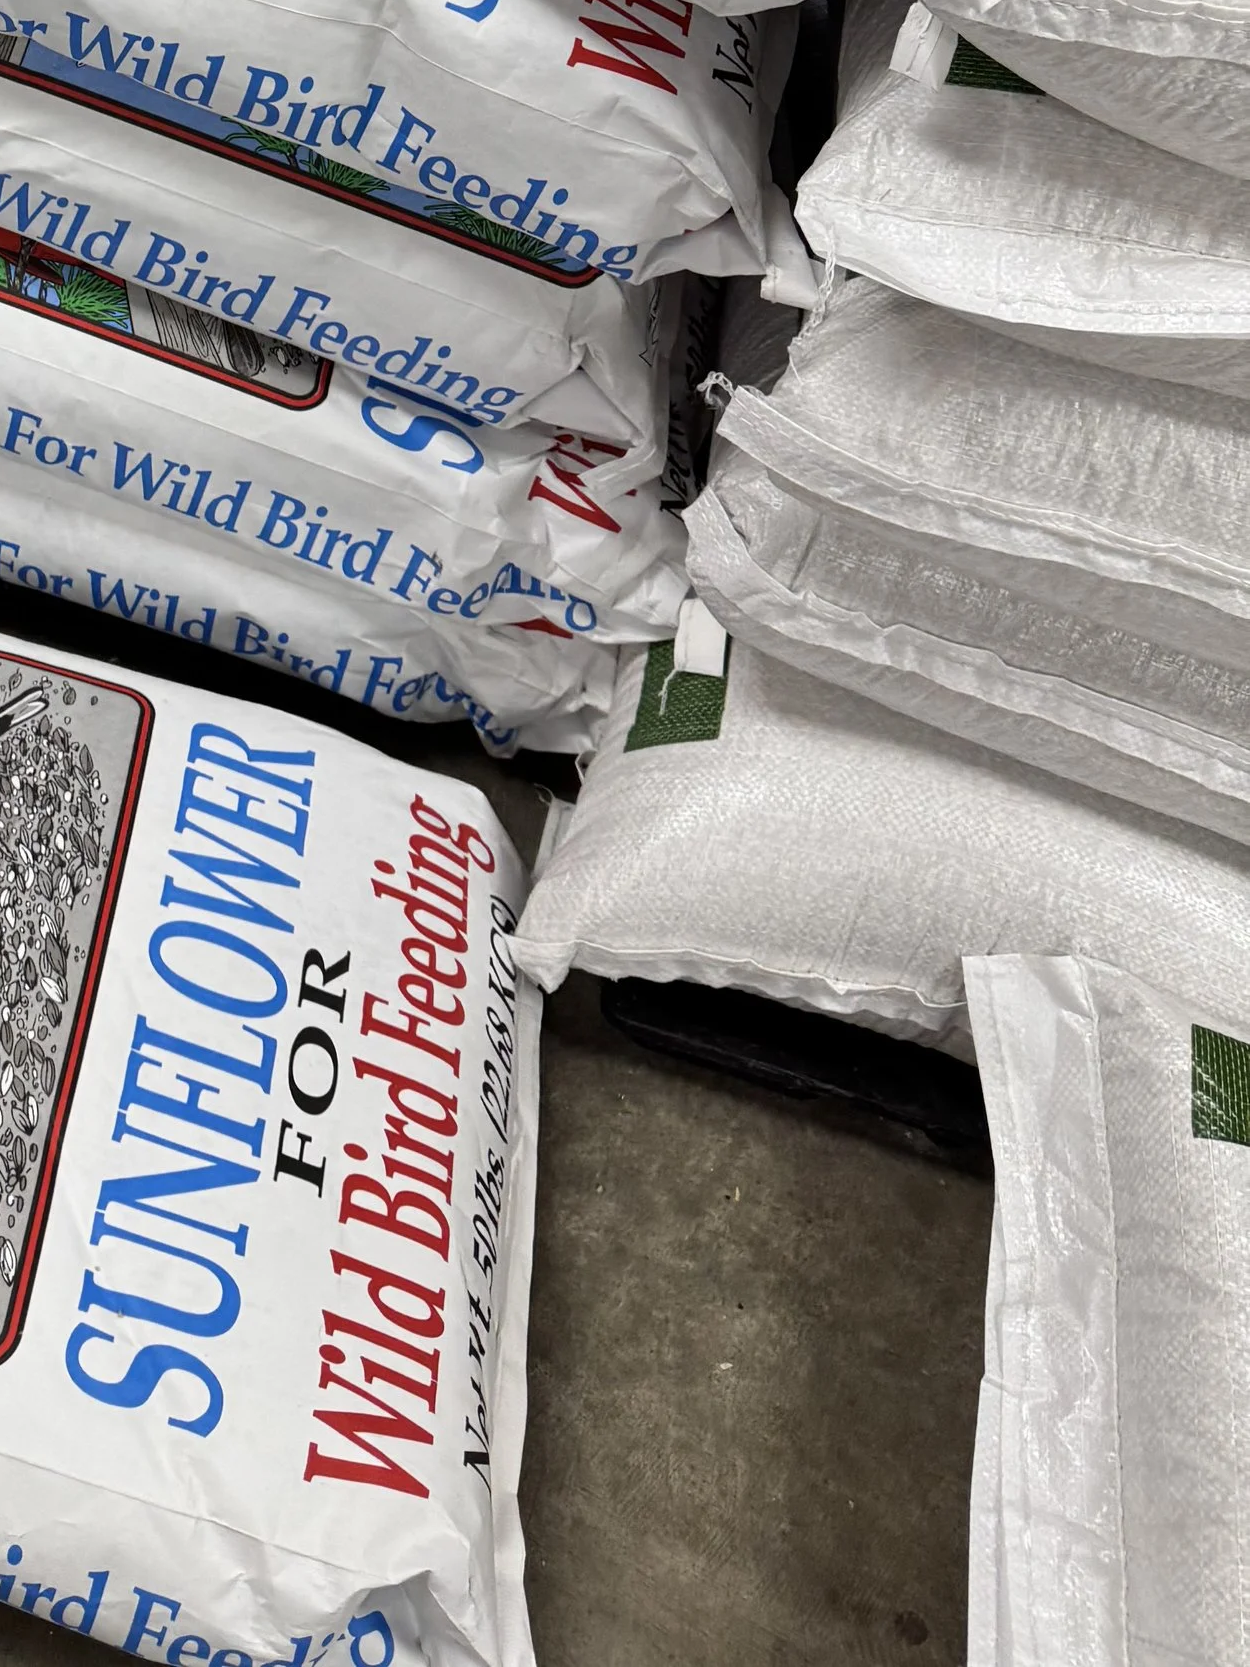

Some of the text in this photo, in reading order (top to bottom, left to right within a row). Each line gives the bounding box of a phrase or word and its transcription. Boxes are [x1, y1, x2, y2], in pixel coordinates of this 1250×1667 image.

[65, 11, 225, 109] Wild
[233, 65, 386, 151] Bird
[374, 107, 639, 281] Feeding
[145, 232, 275, 327] Bird
[271, 287, 524, 426] Feeding
[0, 407, 97, 476] For
[112, 441, 250, 532] Wild
[256, 490, 394, 585] Bird
[86, 571, 217, 644] Wild
[234, 616, 352, 693] Bird
[361, 795, 495, 1062] Feeding
[65, 722, 317, 1438] SUNFLOWER
[273, 949, 351, 1199] FOR
[338, 1058, 457, 1263] Bird
[480, 1006, 515, 1145] (22.68
[303, 1248, 445, 1500] Wild
